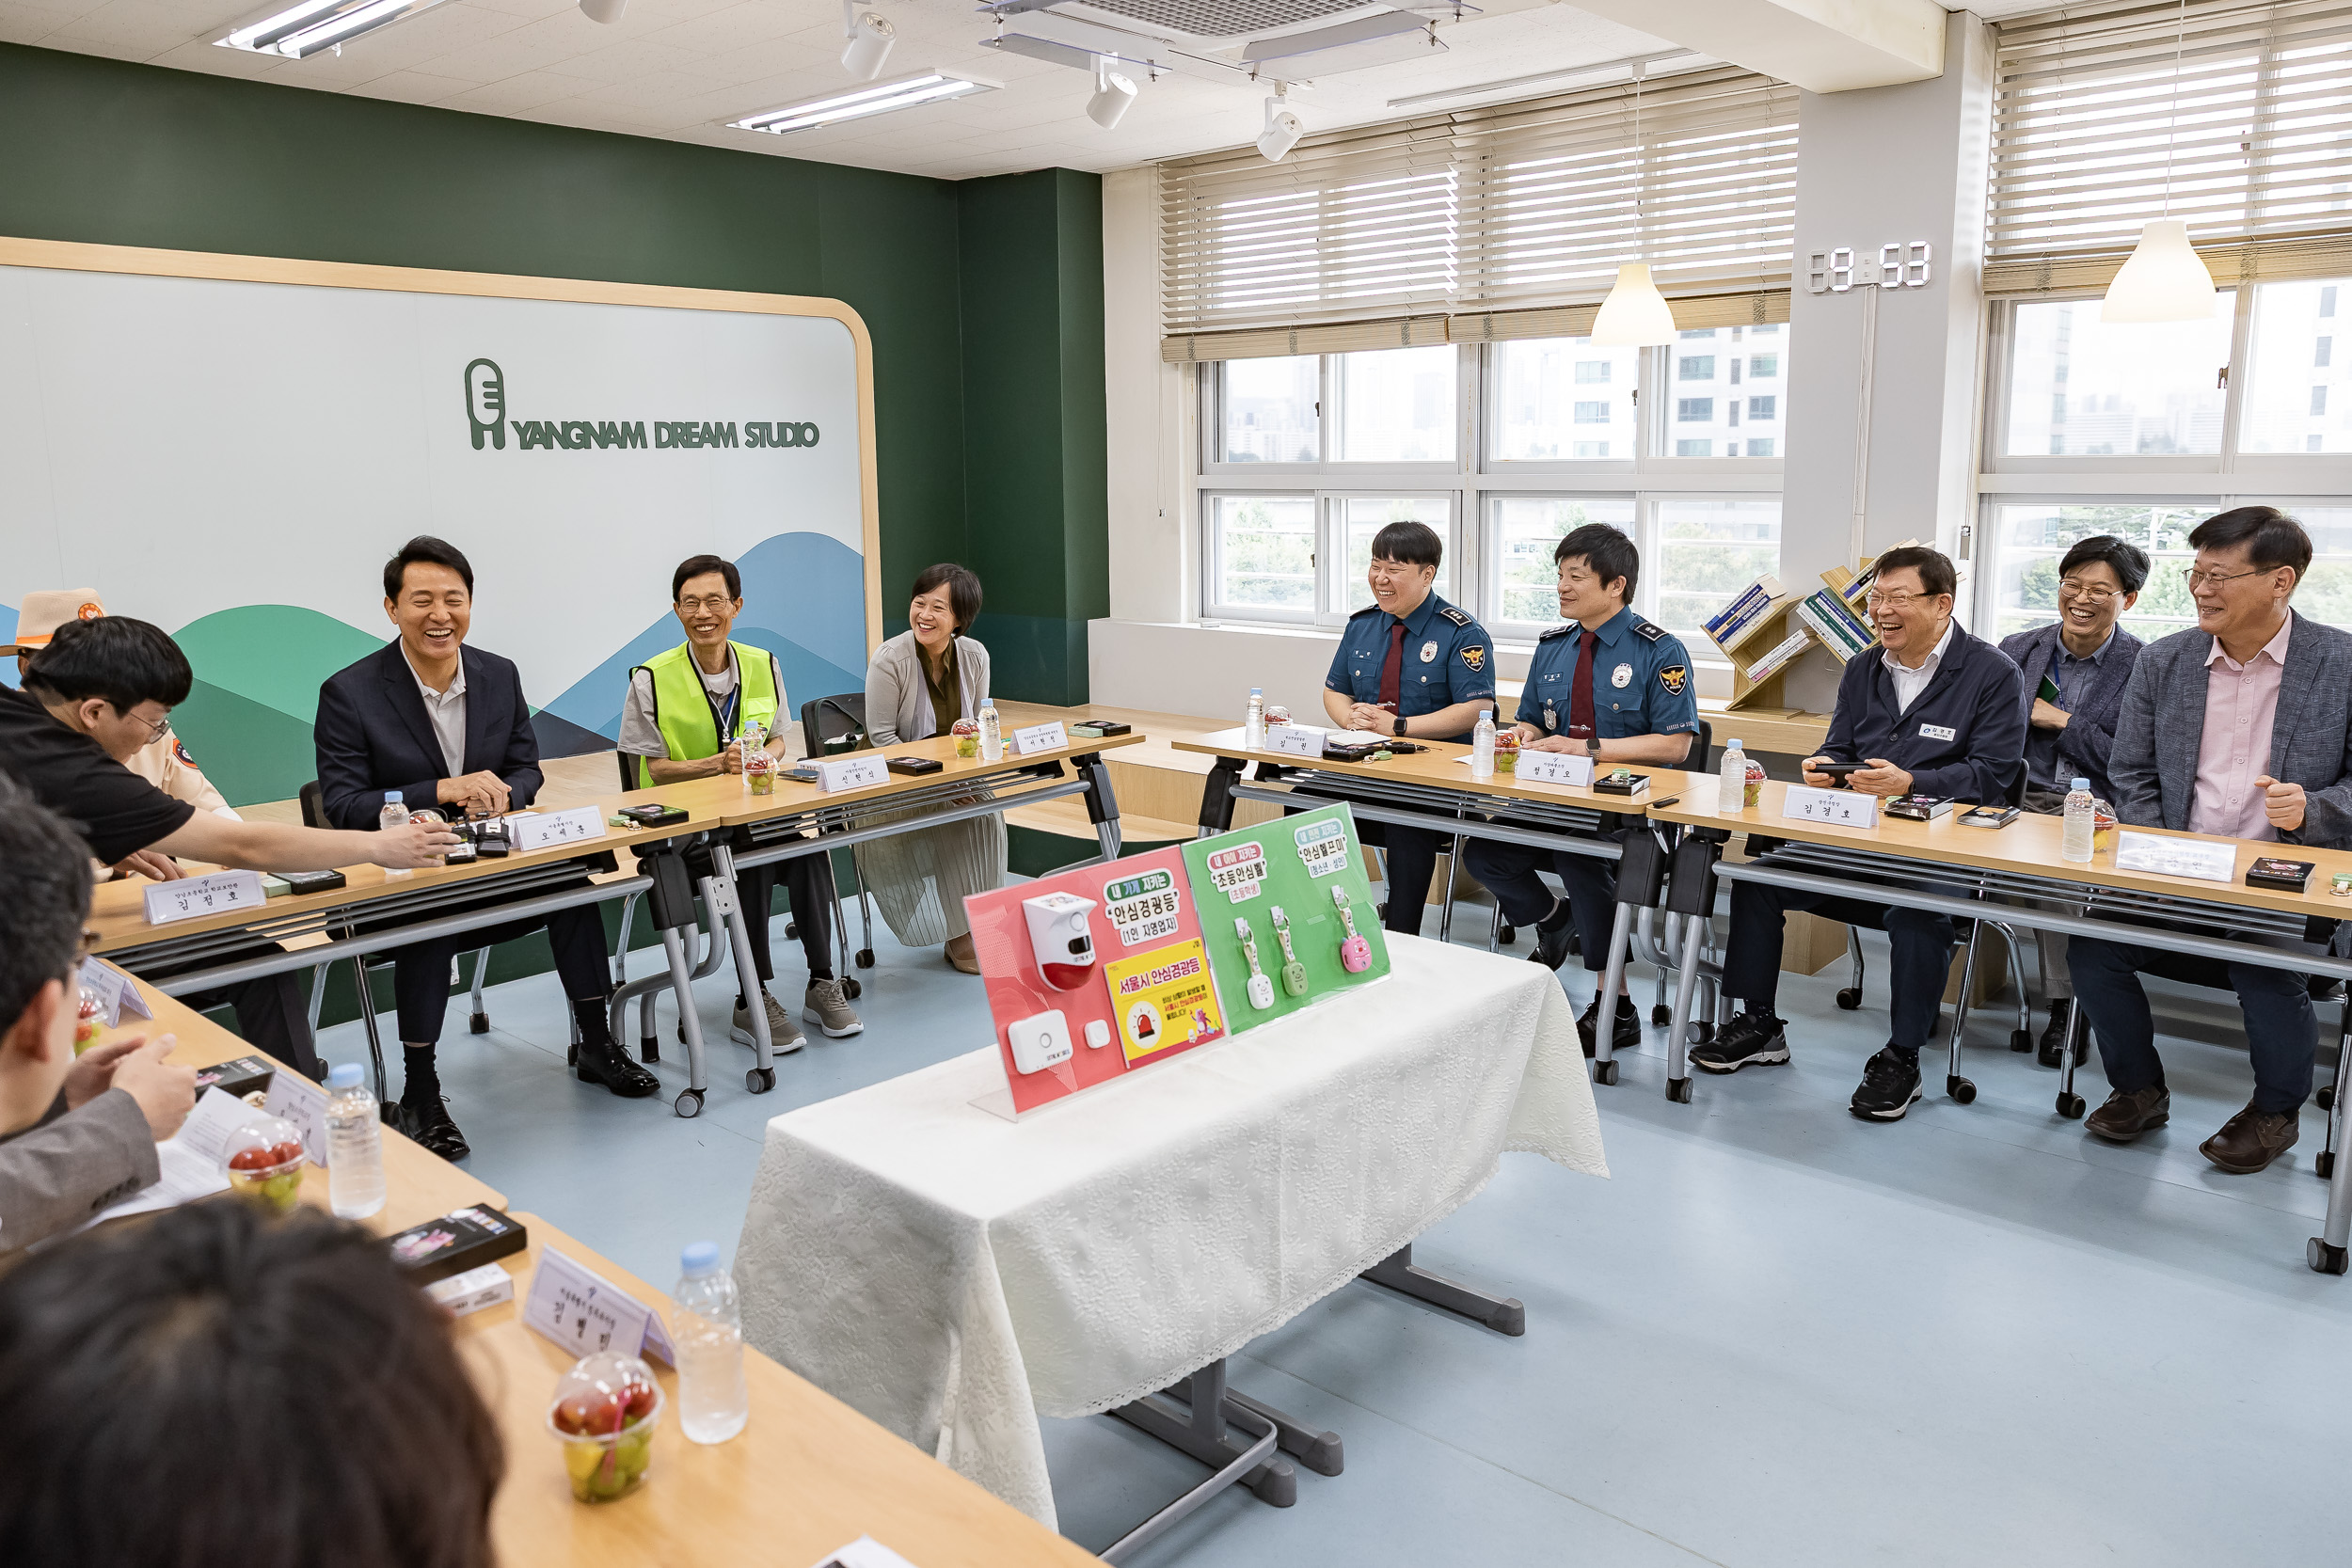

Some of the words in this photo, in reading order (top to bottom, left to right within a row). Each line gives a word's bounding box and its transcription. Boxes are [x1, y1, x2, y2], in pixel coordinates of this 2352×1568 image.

[511, 420, 648, 450] YANGNAM
[654, 421, 739, 449] DREAM
[744, 421, 819, 448] STUDIO
[1110, 884, 1121, 899] 내
[1123, 880, 1140, 895] 가게
[1142, 875, 1167, 891] 지키는
[1120, 973, 1151, 994] 서울시
[1151, 958, 1200, 985] 안심경광등
